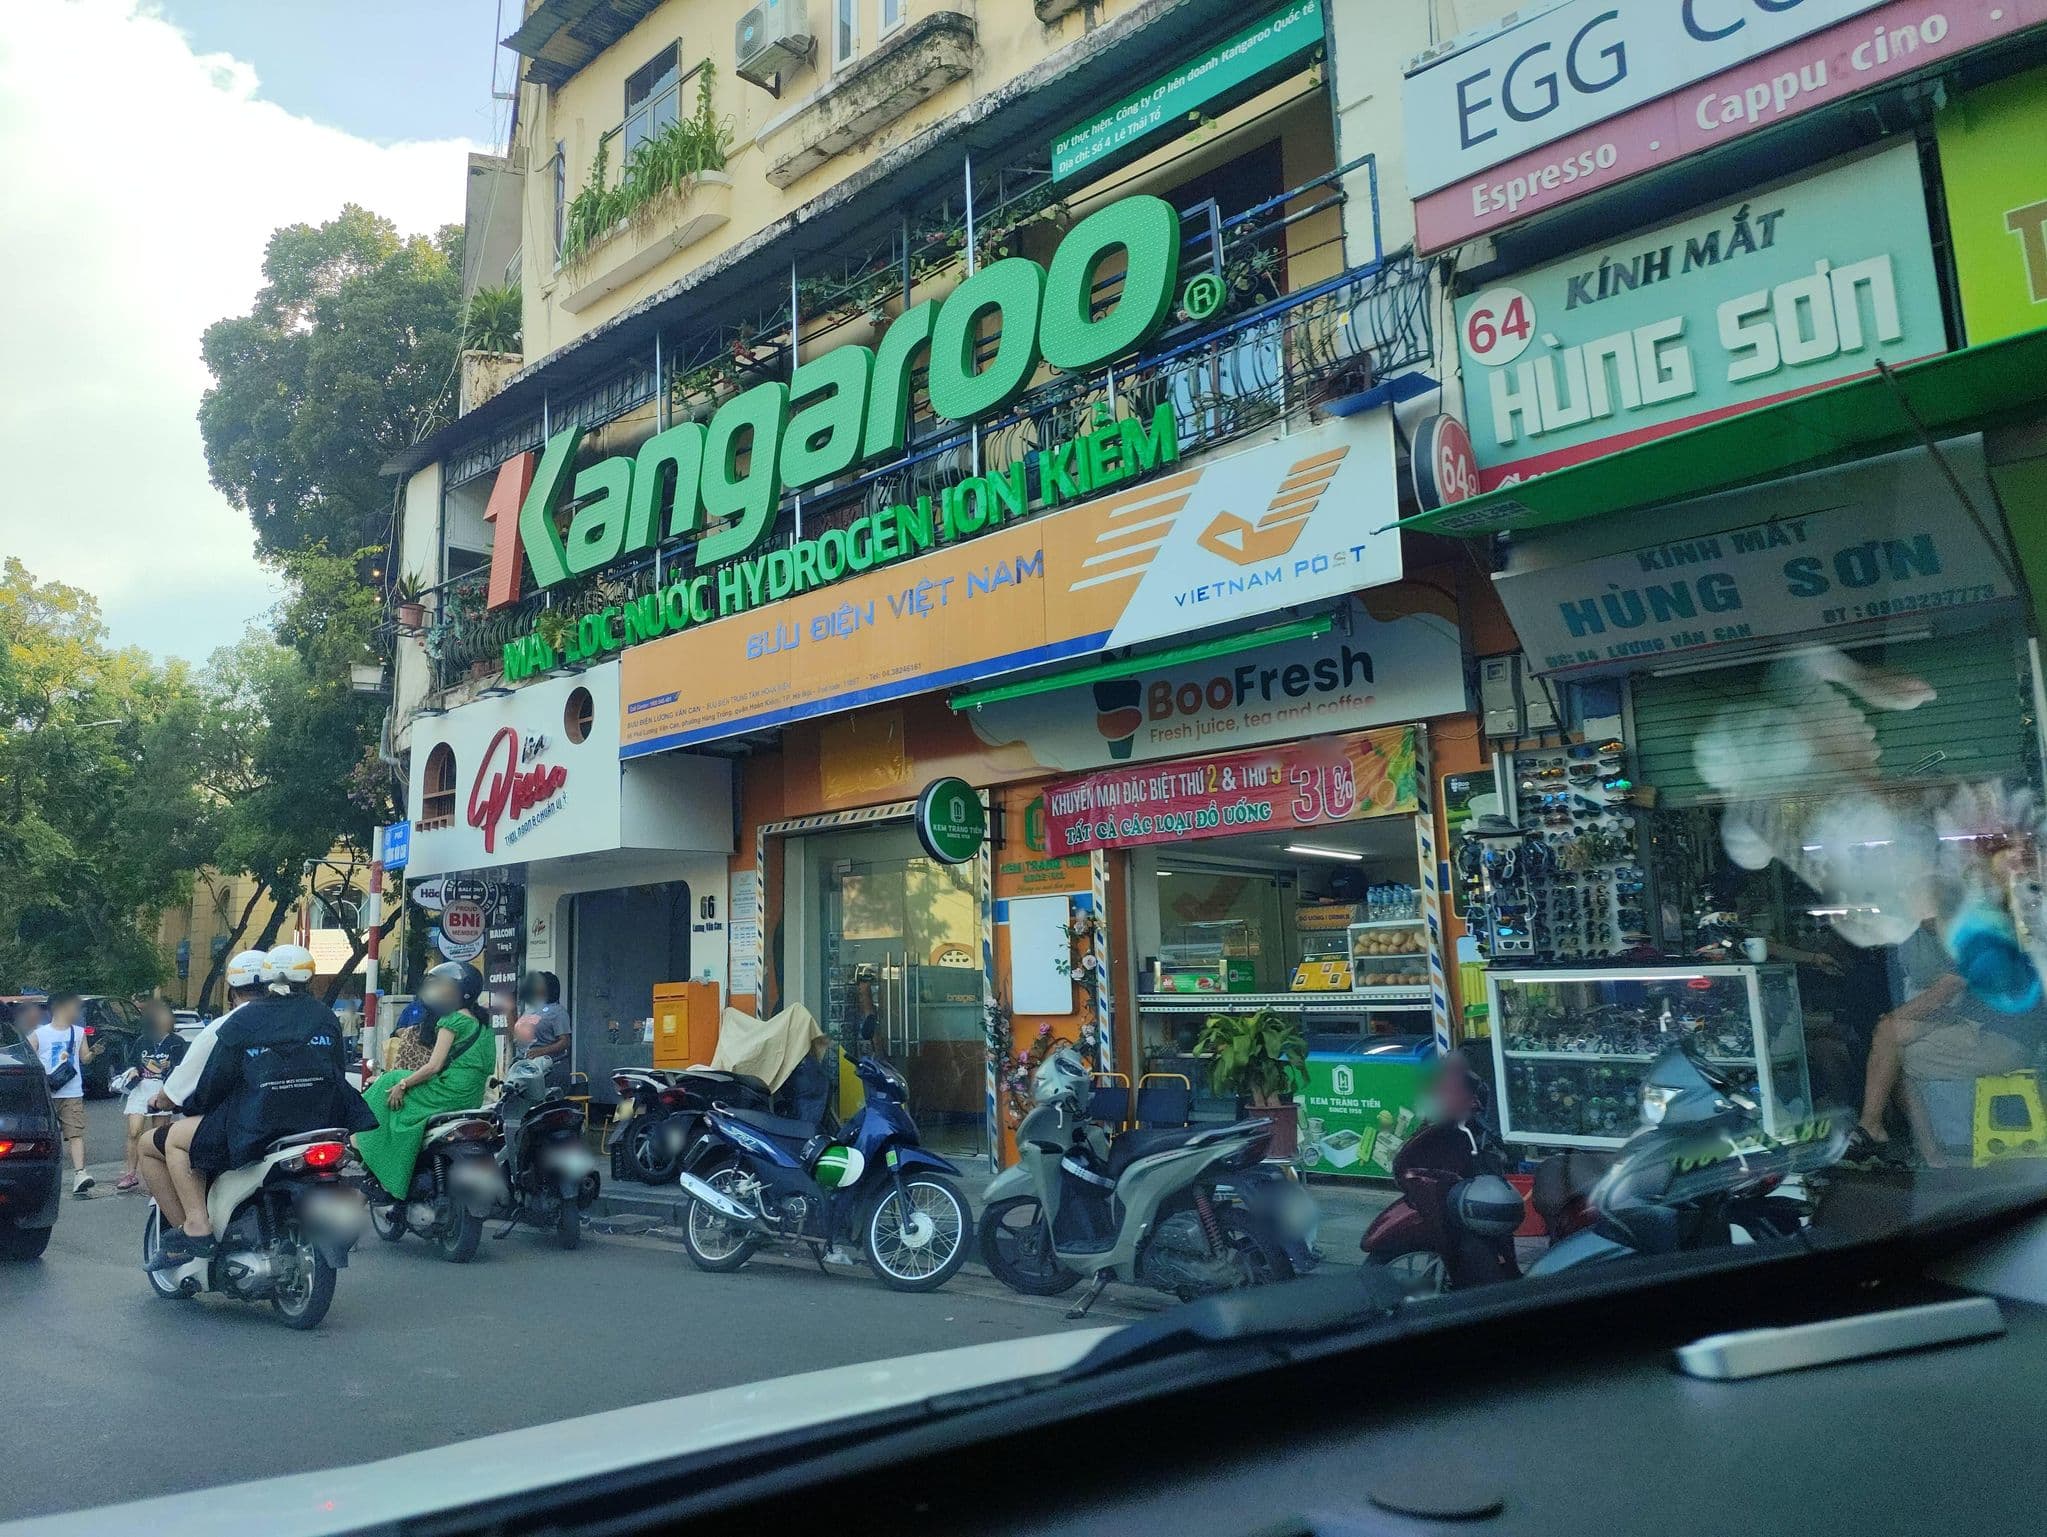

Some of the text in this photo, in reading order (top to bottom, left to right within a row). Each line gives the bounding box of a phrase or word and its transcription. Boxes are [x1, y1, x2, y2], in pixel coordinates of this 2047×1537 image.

[1056, 0, 1316, 155] DV thực hiện: Công ty CP liên doanh Kangaroo Quốc tế
[1457, 9, 1629, 151] EGG
[1059, 158, 1074, 173] Địa
[1091, 137, 1103, 155] Số
[1104, 137, 1111, 147] 4
[1115, 127, 1126, 142] Lê
[1127, 115, 1147, 135] Thái
[1149, 105, 1161, 121] Tổ
[1472, 141, 1618, 218] Espresso
[1564, 204, 1785, 311] KÍNH MẮT
[1467, 297, 1531, 354] 64
[1489, 254, 1903, 445] HÙNG SƠN
[624, 566, 714, 645] NƯỚC
[719, 495, 935, 617] HYDROGEN
[942, 461, 1028, 541] ION
[1039, 399, 1180, 506] KIỂM
[1636, 512, 1808, 572] KÍNH MẮT
[746, 549, 1044, 660] BƯU ĐIỆN VIỆT NAM
[1175, 545, 1366, 608] VIETNAM POST
[1559, 532, 1943, 638] HÙNG SƠN
[1147, 644, 1374, 722] BooFresh
[1150, 694, 1377, 744] Fresh juice, tea and coffee
[1051, 782, 1094, 817] KHUYẾN
[1096, 782, 1121, 813] MẠI
[1123, 776, 1147, 811] ĐẶC
[1149, 771, 1176, 807] BIỆT
[1177, 766, 1204, 796] THỨ
[1206, 764, 1218, 794] 2
[1222, 767, 1237, 792] &
[1065, 796, 1273, 845] TẤT CẢ CÁC LOẠI ĐỒ UỐNG
[932, 823, 947, 832] KEM
[948, 823, 968, 834] TRÀNG
[700, 895, 715, 920] 66
[1310, 1095, 1381, 1109] KEM TRÀNG TIỀN
